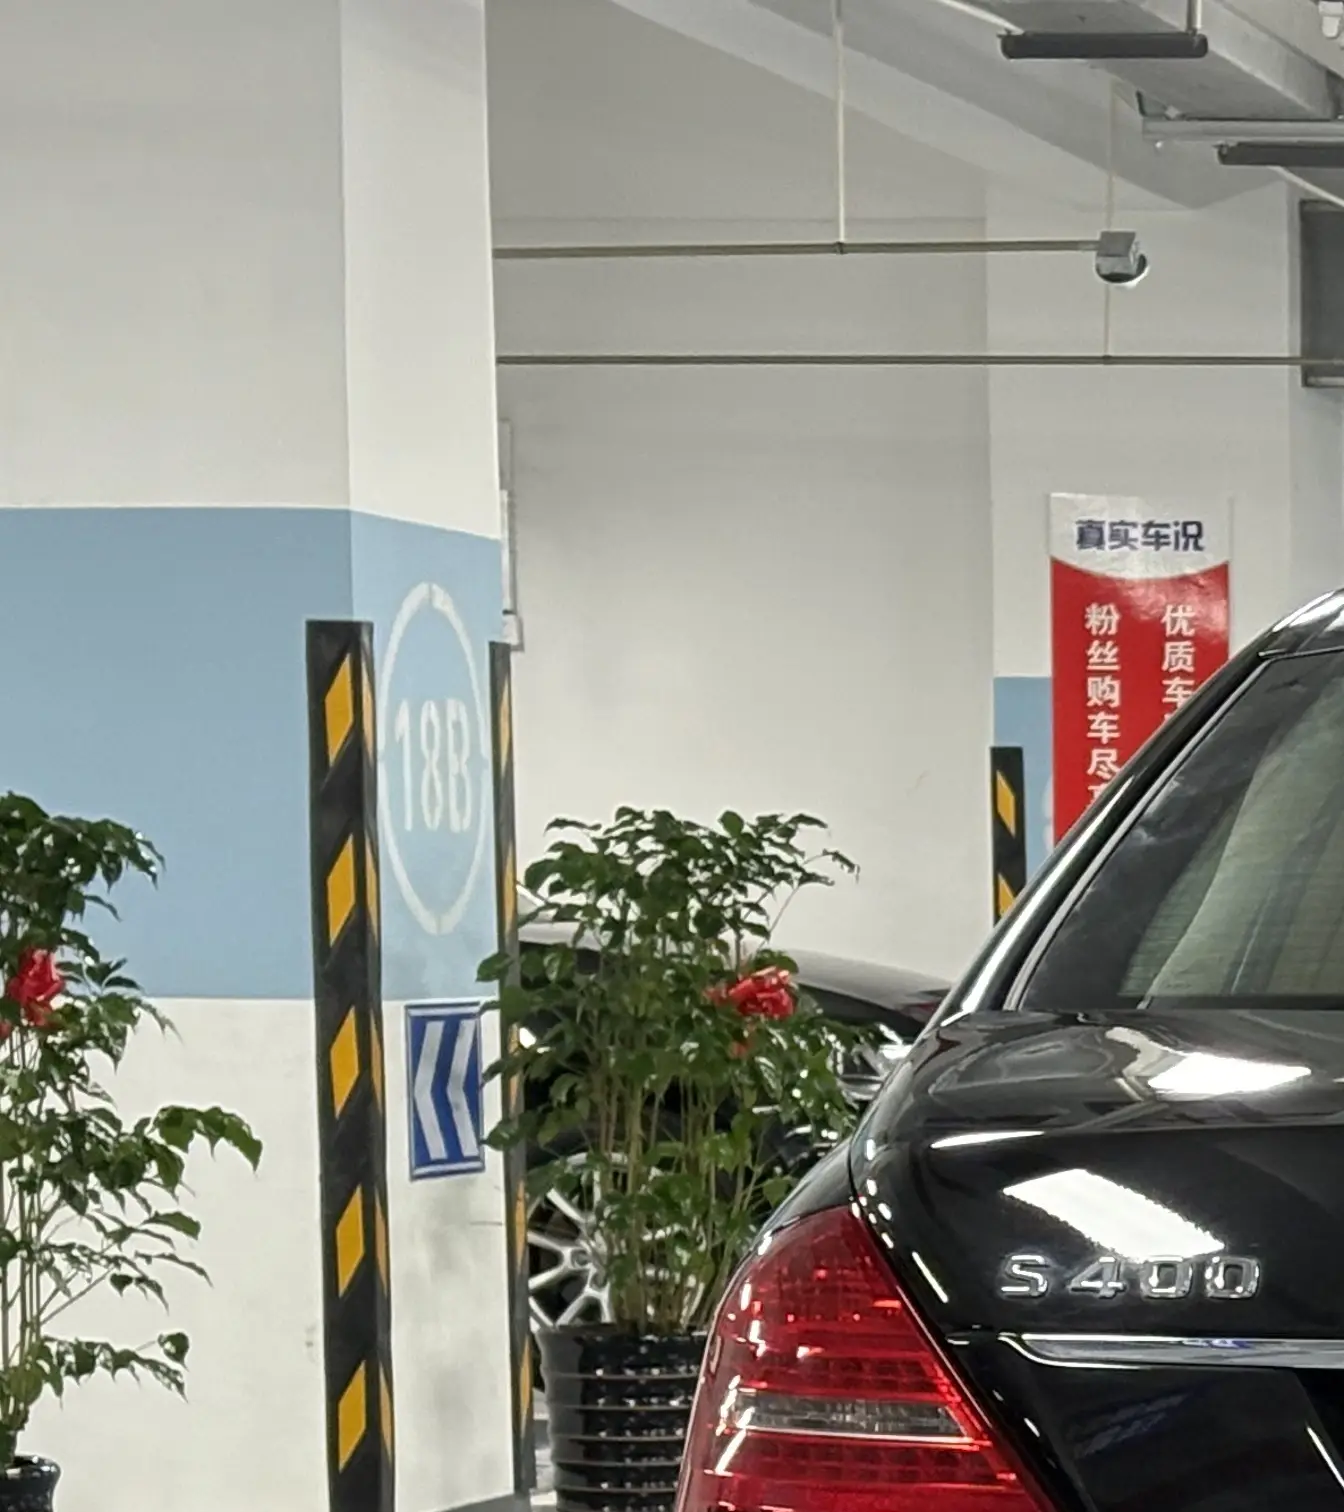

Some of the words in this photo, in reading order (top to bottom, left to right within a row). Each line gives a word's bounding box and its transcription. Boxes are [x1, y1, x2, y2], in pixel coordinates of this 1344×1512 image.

[1074, 519, 1205, 552] 真实车况
[1160, 604, 1196, 725] 优质车
[395, 698, 472, 833] 18B
